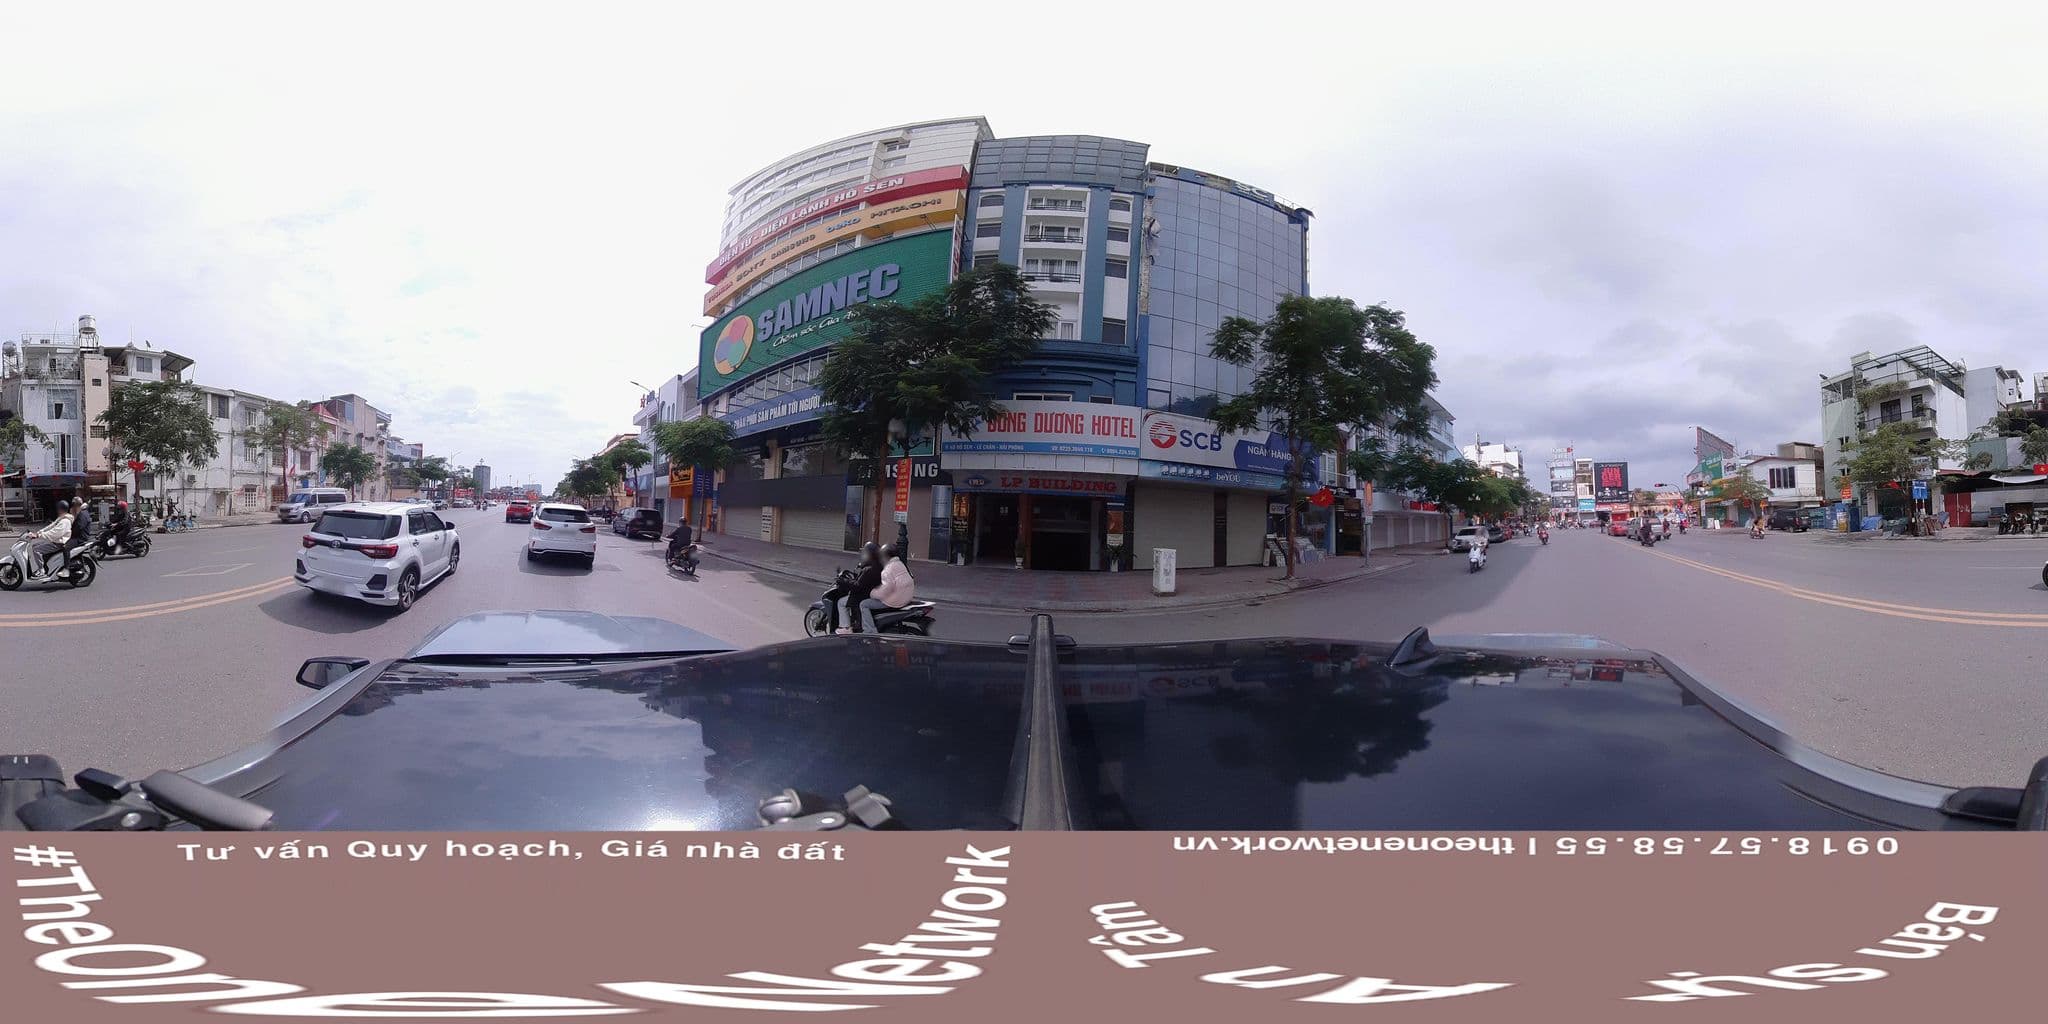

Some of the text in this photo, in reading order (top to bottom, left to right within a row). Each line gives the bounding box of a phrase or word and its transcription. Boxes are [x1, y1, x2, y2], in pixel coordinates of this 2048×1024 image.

[864, 177, 904, 193] SEN
[757, 263, 900, 342] SAMNEC
[1034, 411, 1085, 435] DƯƠNG
[1092, 415, 1137, 438] HOTEL
[1180, 429, 1222, 452] SCB
[1001, 476, 1118, 493] LP BUILDING
